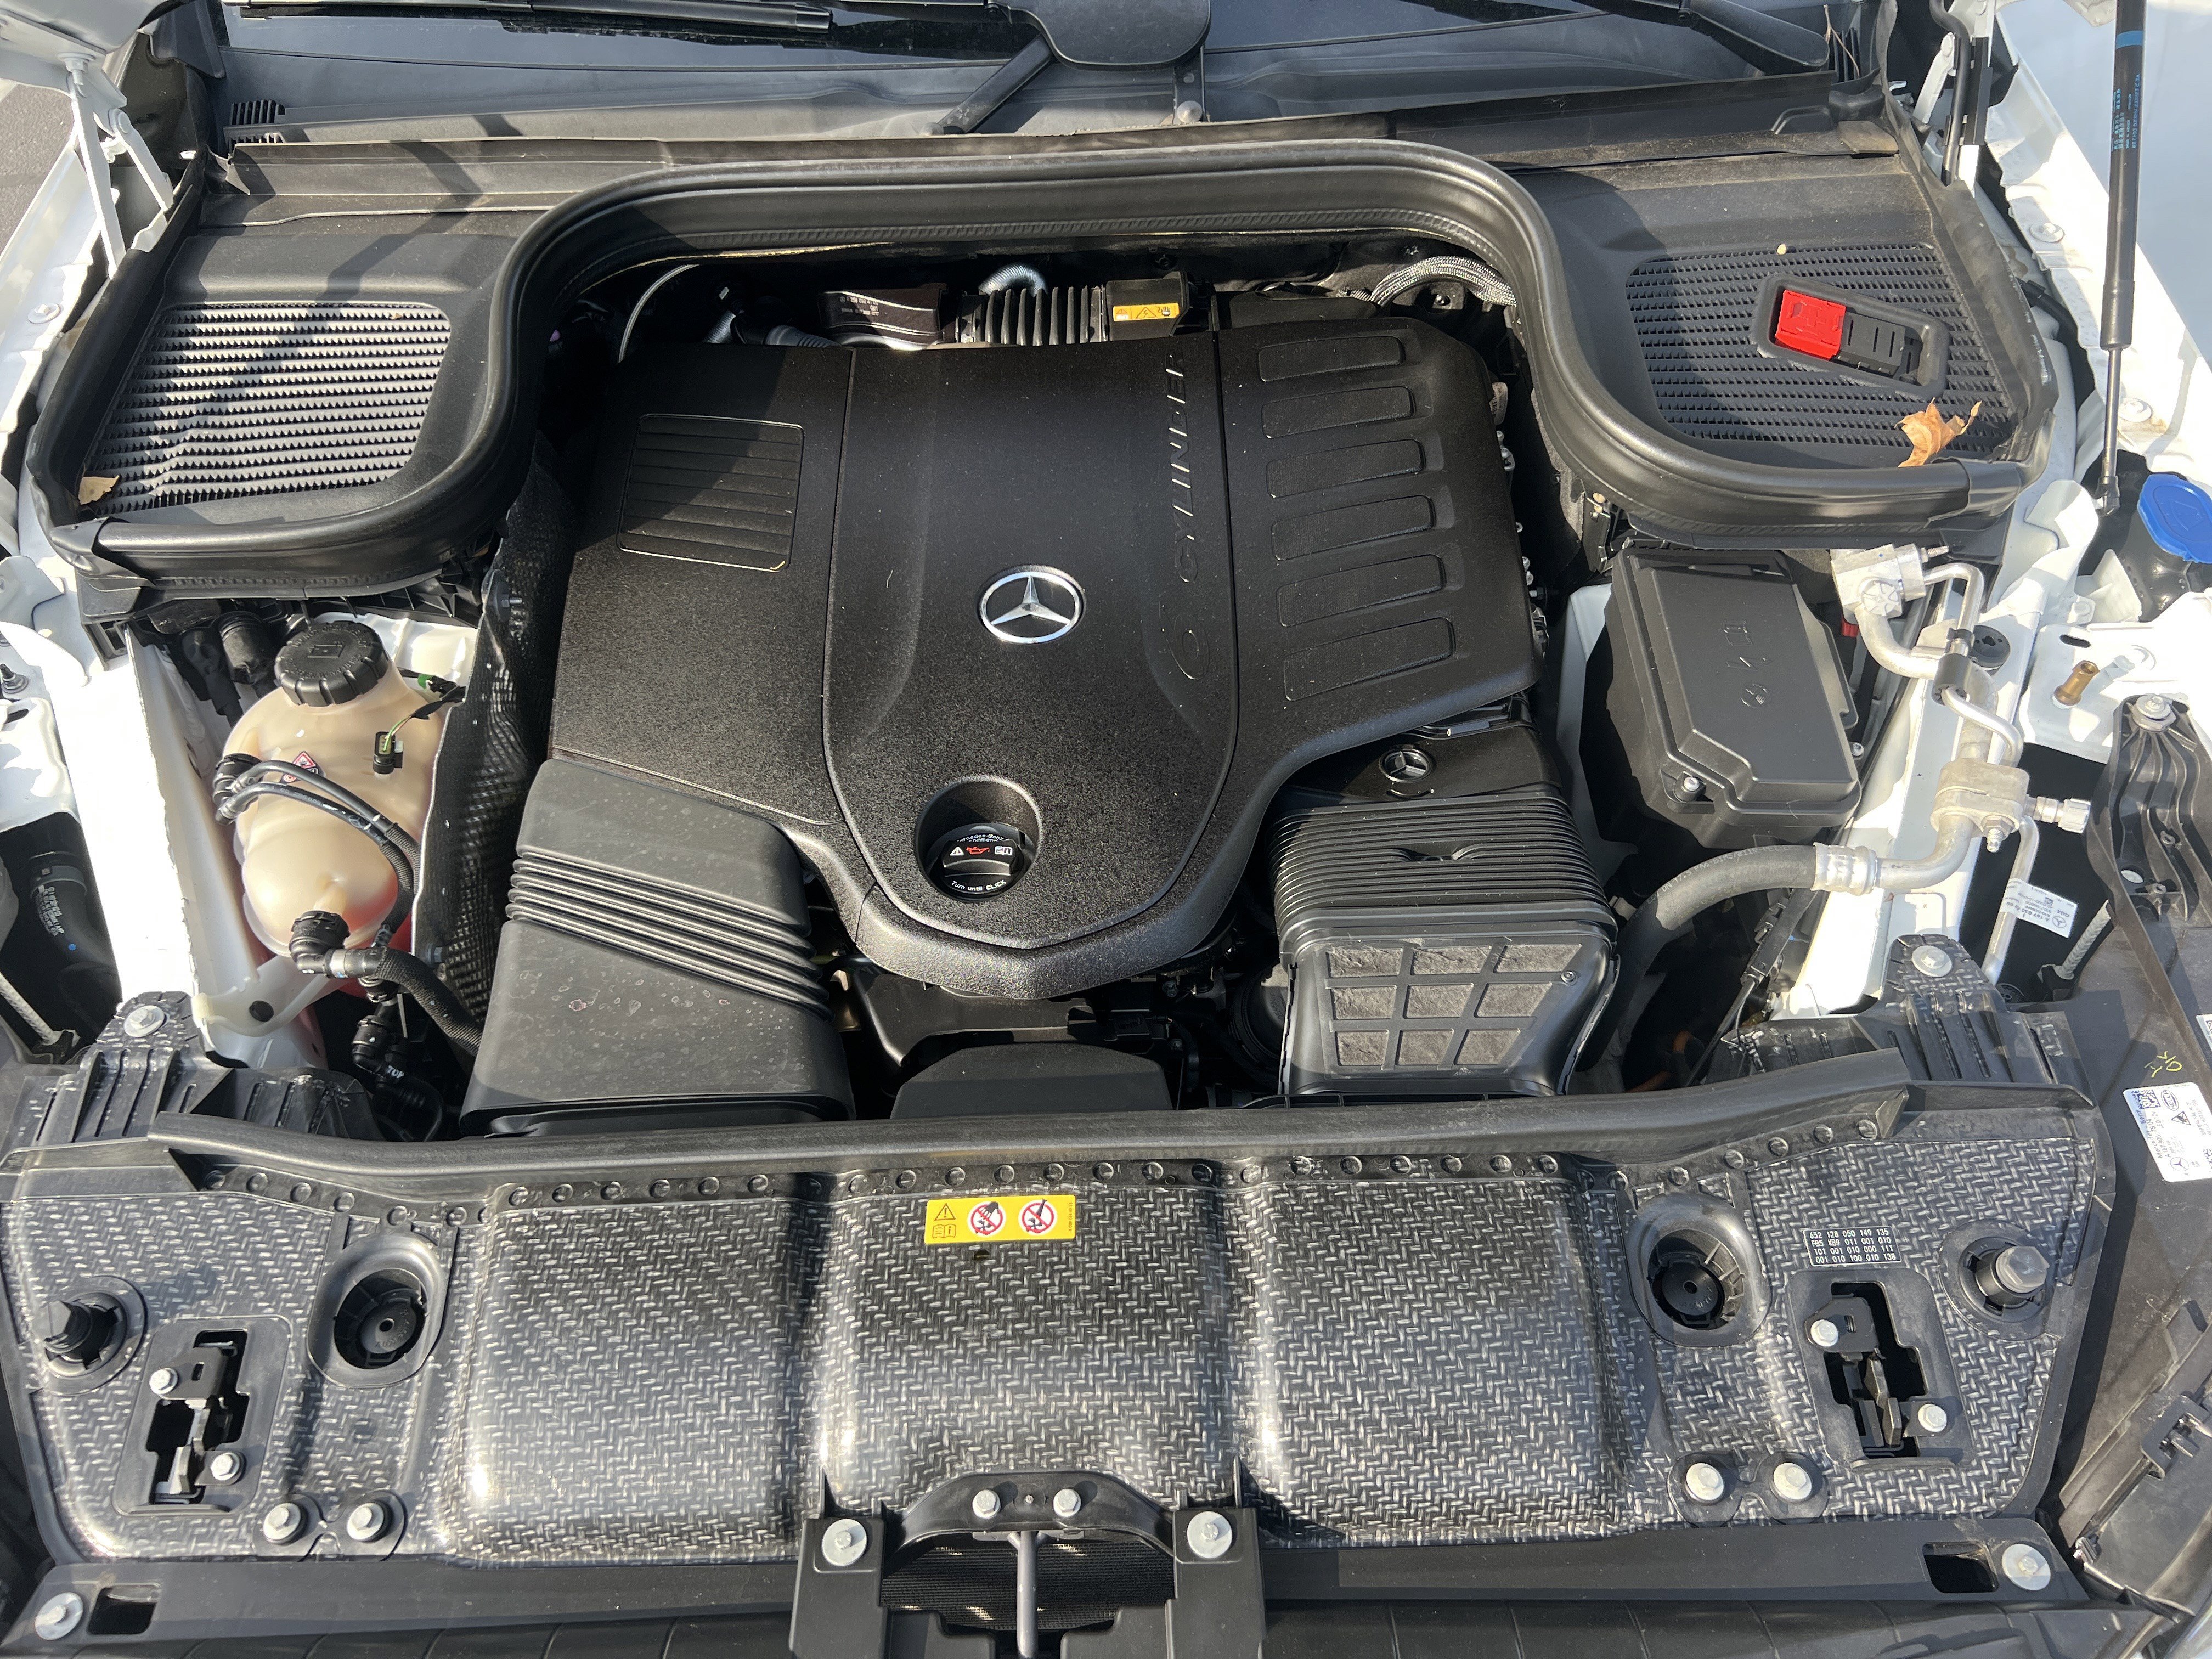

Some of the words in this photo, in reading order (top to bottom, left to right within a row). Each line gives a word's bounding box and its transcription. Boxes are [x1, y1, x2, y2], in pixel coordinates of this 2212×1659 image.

[1165, 351, 1198, 583] CYLINDER
[951, 881, 966, 889] Turn
[985, 879, 1006, 890] CLICK
[387, 1065, 404, 1078] TOP
[2163, 1090, 2176, 1109] HELLA
[1842, 1229, 1856, 1238] 050
[1876, 1228, 1889, 1236] 135
[1847, 1246, 1860, 1254] 010
